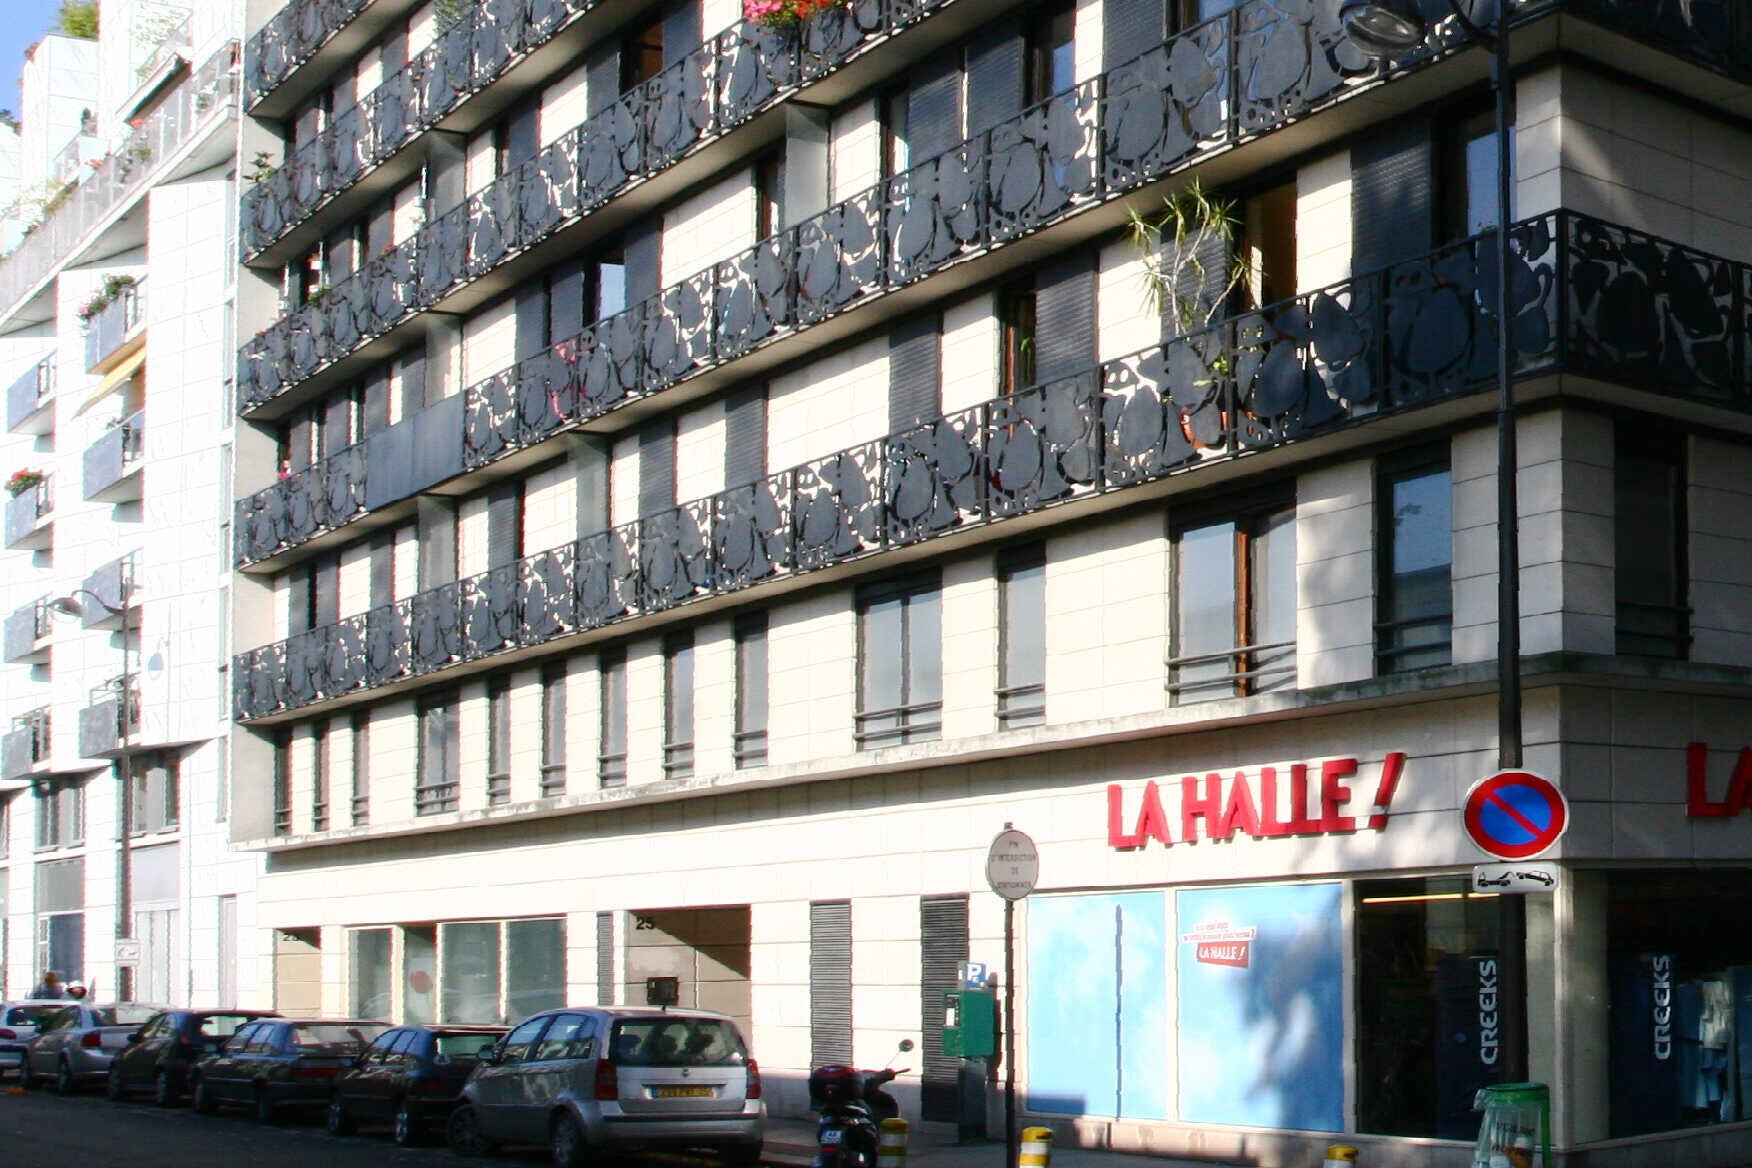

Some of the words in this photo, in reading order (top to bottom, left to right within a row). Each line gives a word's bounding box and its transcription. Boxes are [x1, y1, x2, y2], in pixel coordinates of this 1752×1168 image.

[1108, 781, 1171, 848] LA
[1182, 758, 1357, 840] HALLE
[635, 916, 655, 930] 25
[1200, 946, 1210, 959] LA
[1479, 959, 1499, 1065] CREEKS
[1653, 954, 1672, 1060] CREEKS
